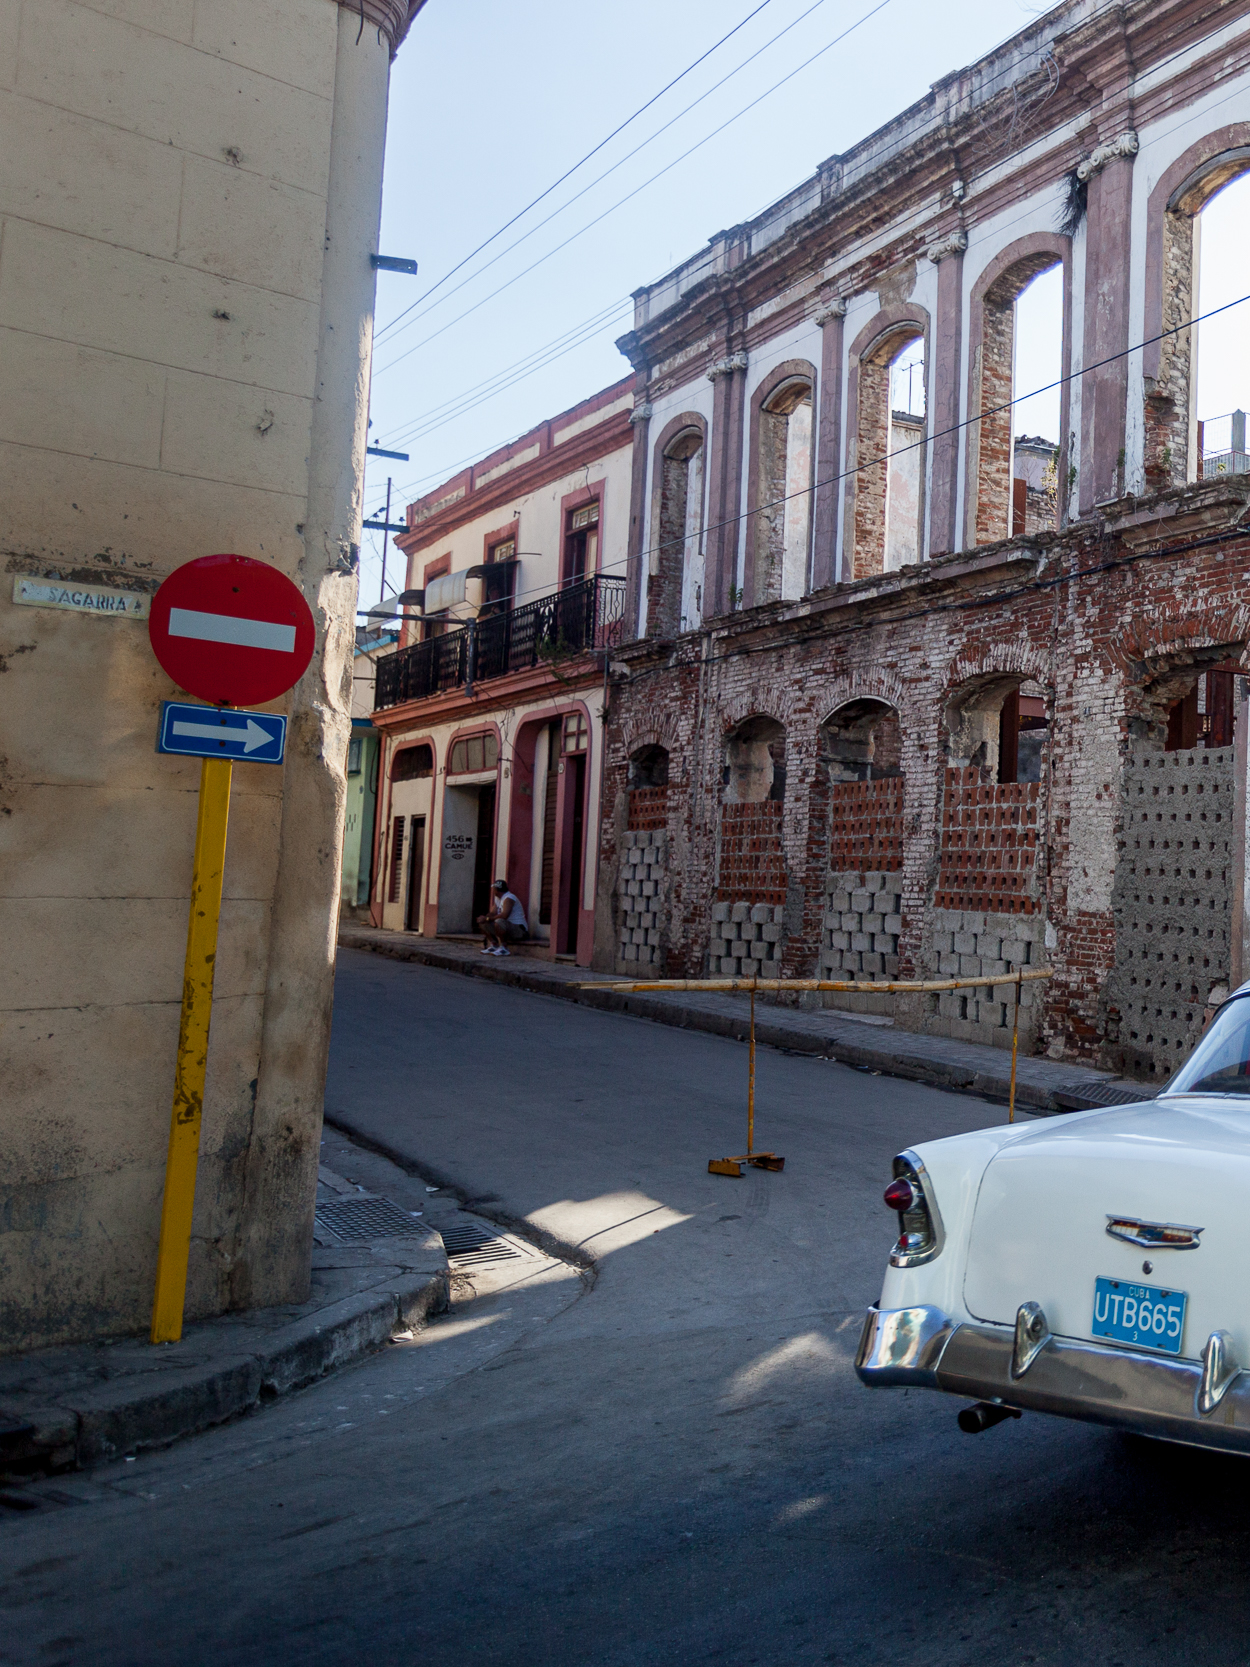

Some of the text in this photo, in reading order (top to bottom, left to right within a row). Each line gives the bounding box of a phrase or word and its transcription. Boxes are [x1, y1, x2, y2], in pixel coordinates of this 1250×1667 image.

[49, 587, 126, 611] SAGARRA
[1129, 1286, 1151, 1299] CUBA
[1095, 1291, 1180, 1337] UTB665
[1133, 1331, 1138, 1341] 3
